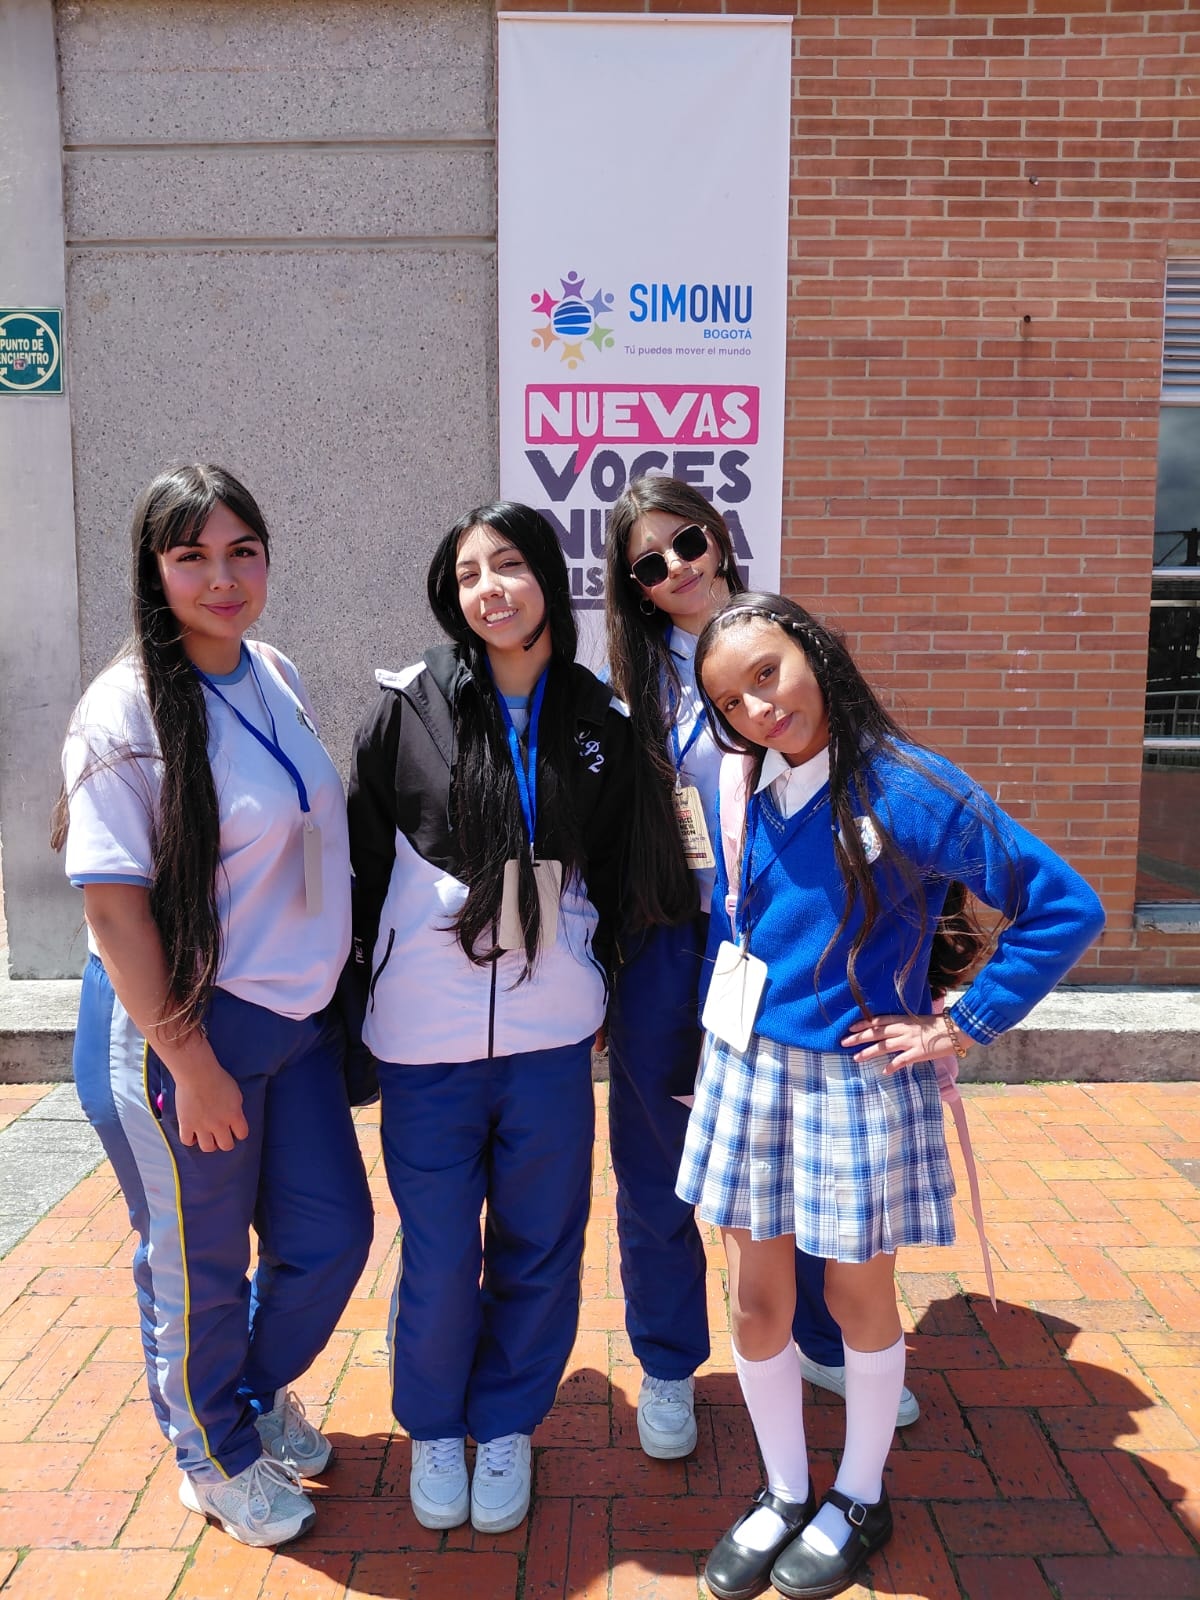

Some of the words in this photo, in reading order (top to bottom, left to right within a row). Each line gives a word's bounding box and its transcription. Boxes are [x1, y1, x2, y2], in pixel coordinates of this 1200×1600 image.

[629, 283, 752, 323] SIMONU
[703, 328, 752, 339] BOGOTÁ
[0, 338, 30, 351] PUNTO
[32, 338, 44, 350] DE
[624, 345, 636, 355] Tú
[638, 346, 673, 357] puedes
[675, 346, 705, 355] mover
[708, 345, 716, 355] el
[719, 345, 751, 356] mundo
[0, 352, 49, 364] NCUENTRO
[528, 391, 751, 438] NUEVAS
